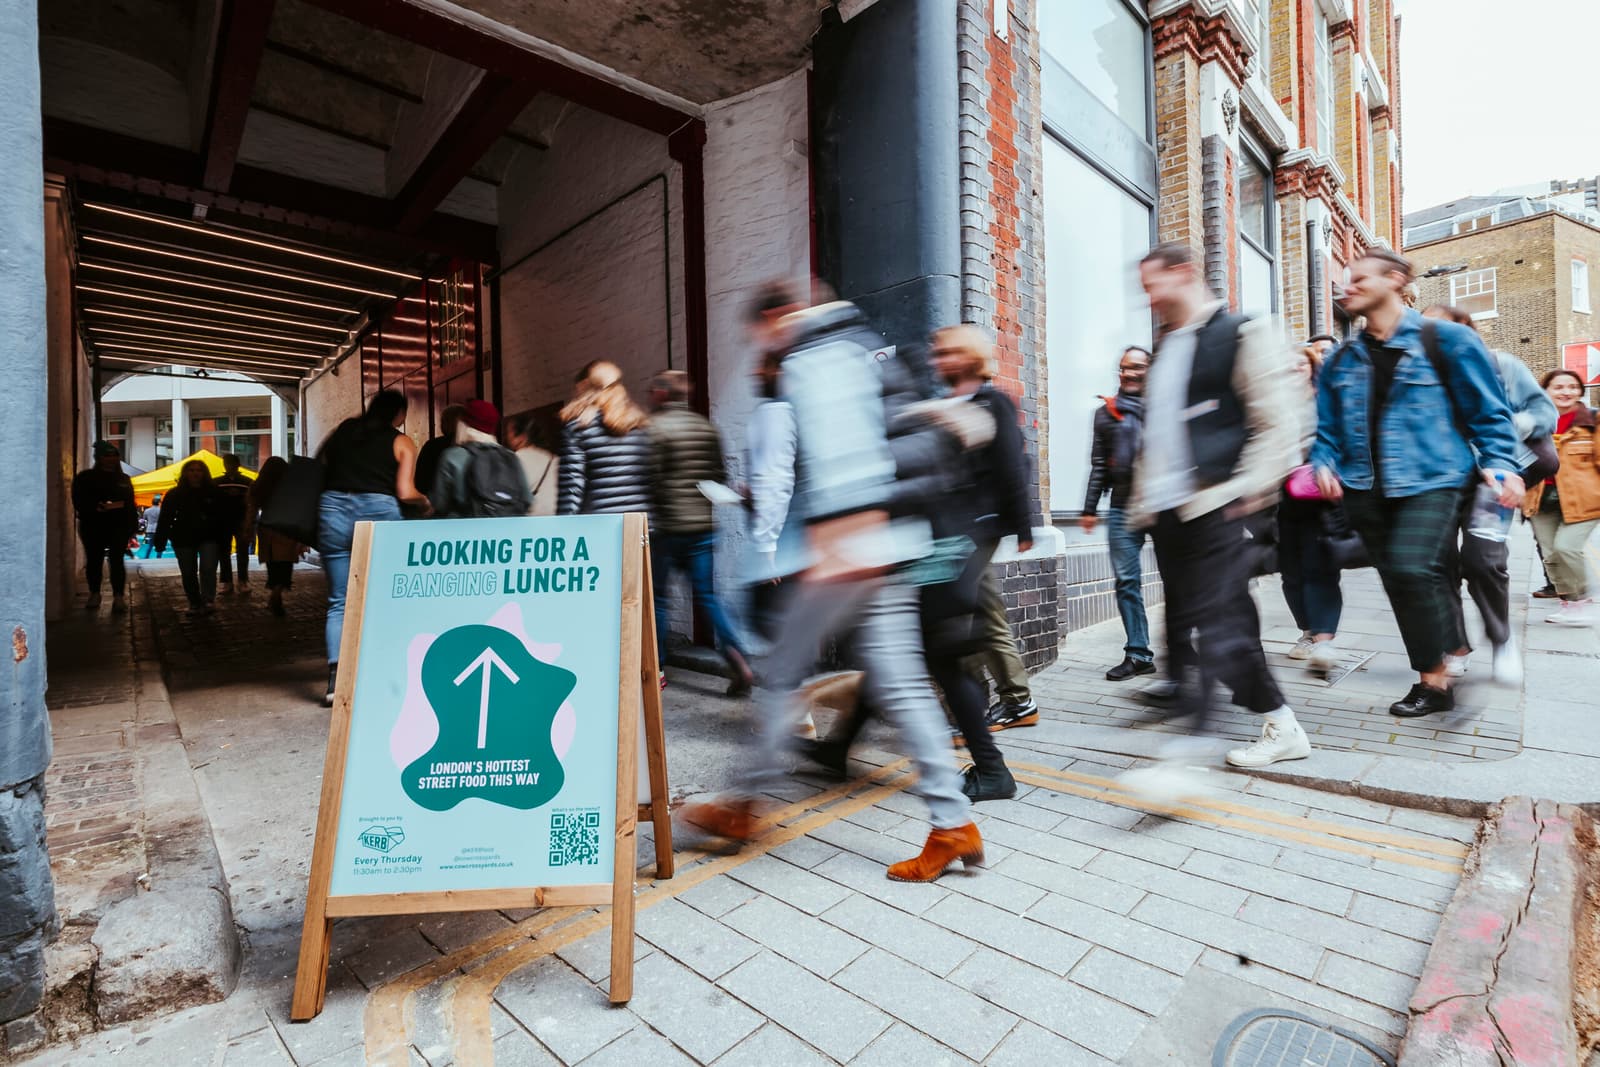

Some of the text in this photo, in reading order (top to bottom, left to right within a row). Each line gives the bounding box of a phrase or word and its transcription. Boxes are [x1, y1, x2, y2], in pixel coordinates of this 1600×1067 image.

[407, 536, 590, 567] LOOKING FOR A
[391, 565, 600, 599] BANGING LUNCH?
[430, 759, 531, 775] LONDON'S HOTTEST
[418, 772, 540, 789] STREET FOOD THIS WAY
[363, 835, 388, 850] KERB
[354, 854, 423, 867] Every Thursday
[384, 866, 392, 875] to
